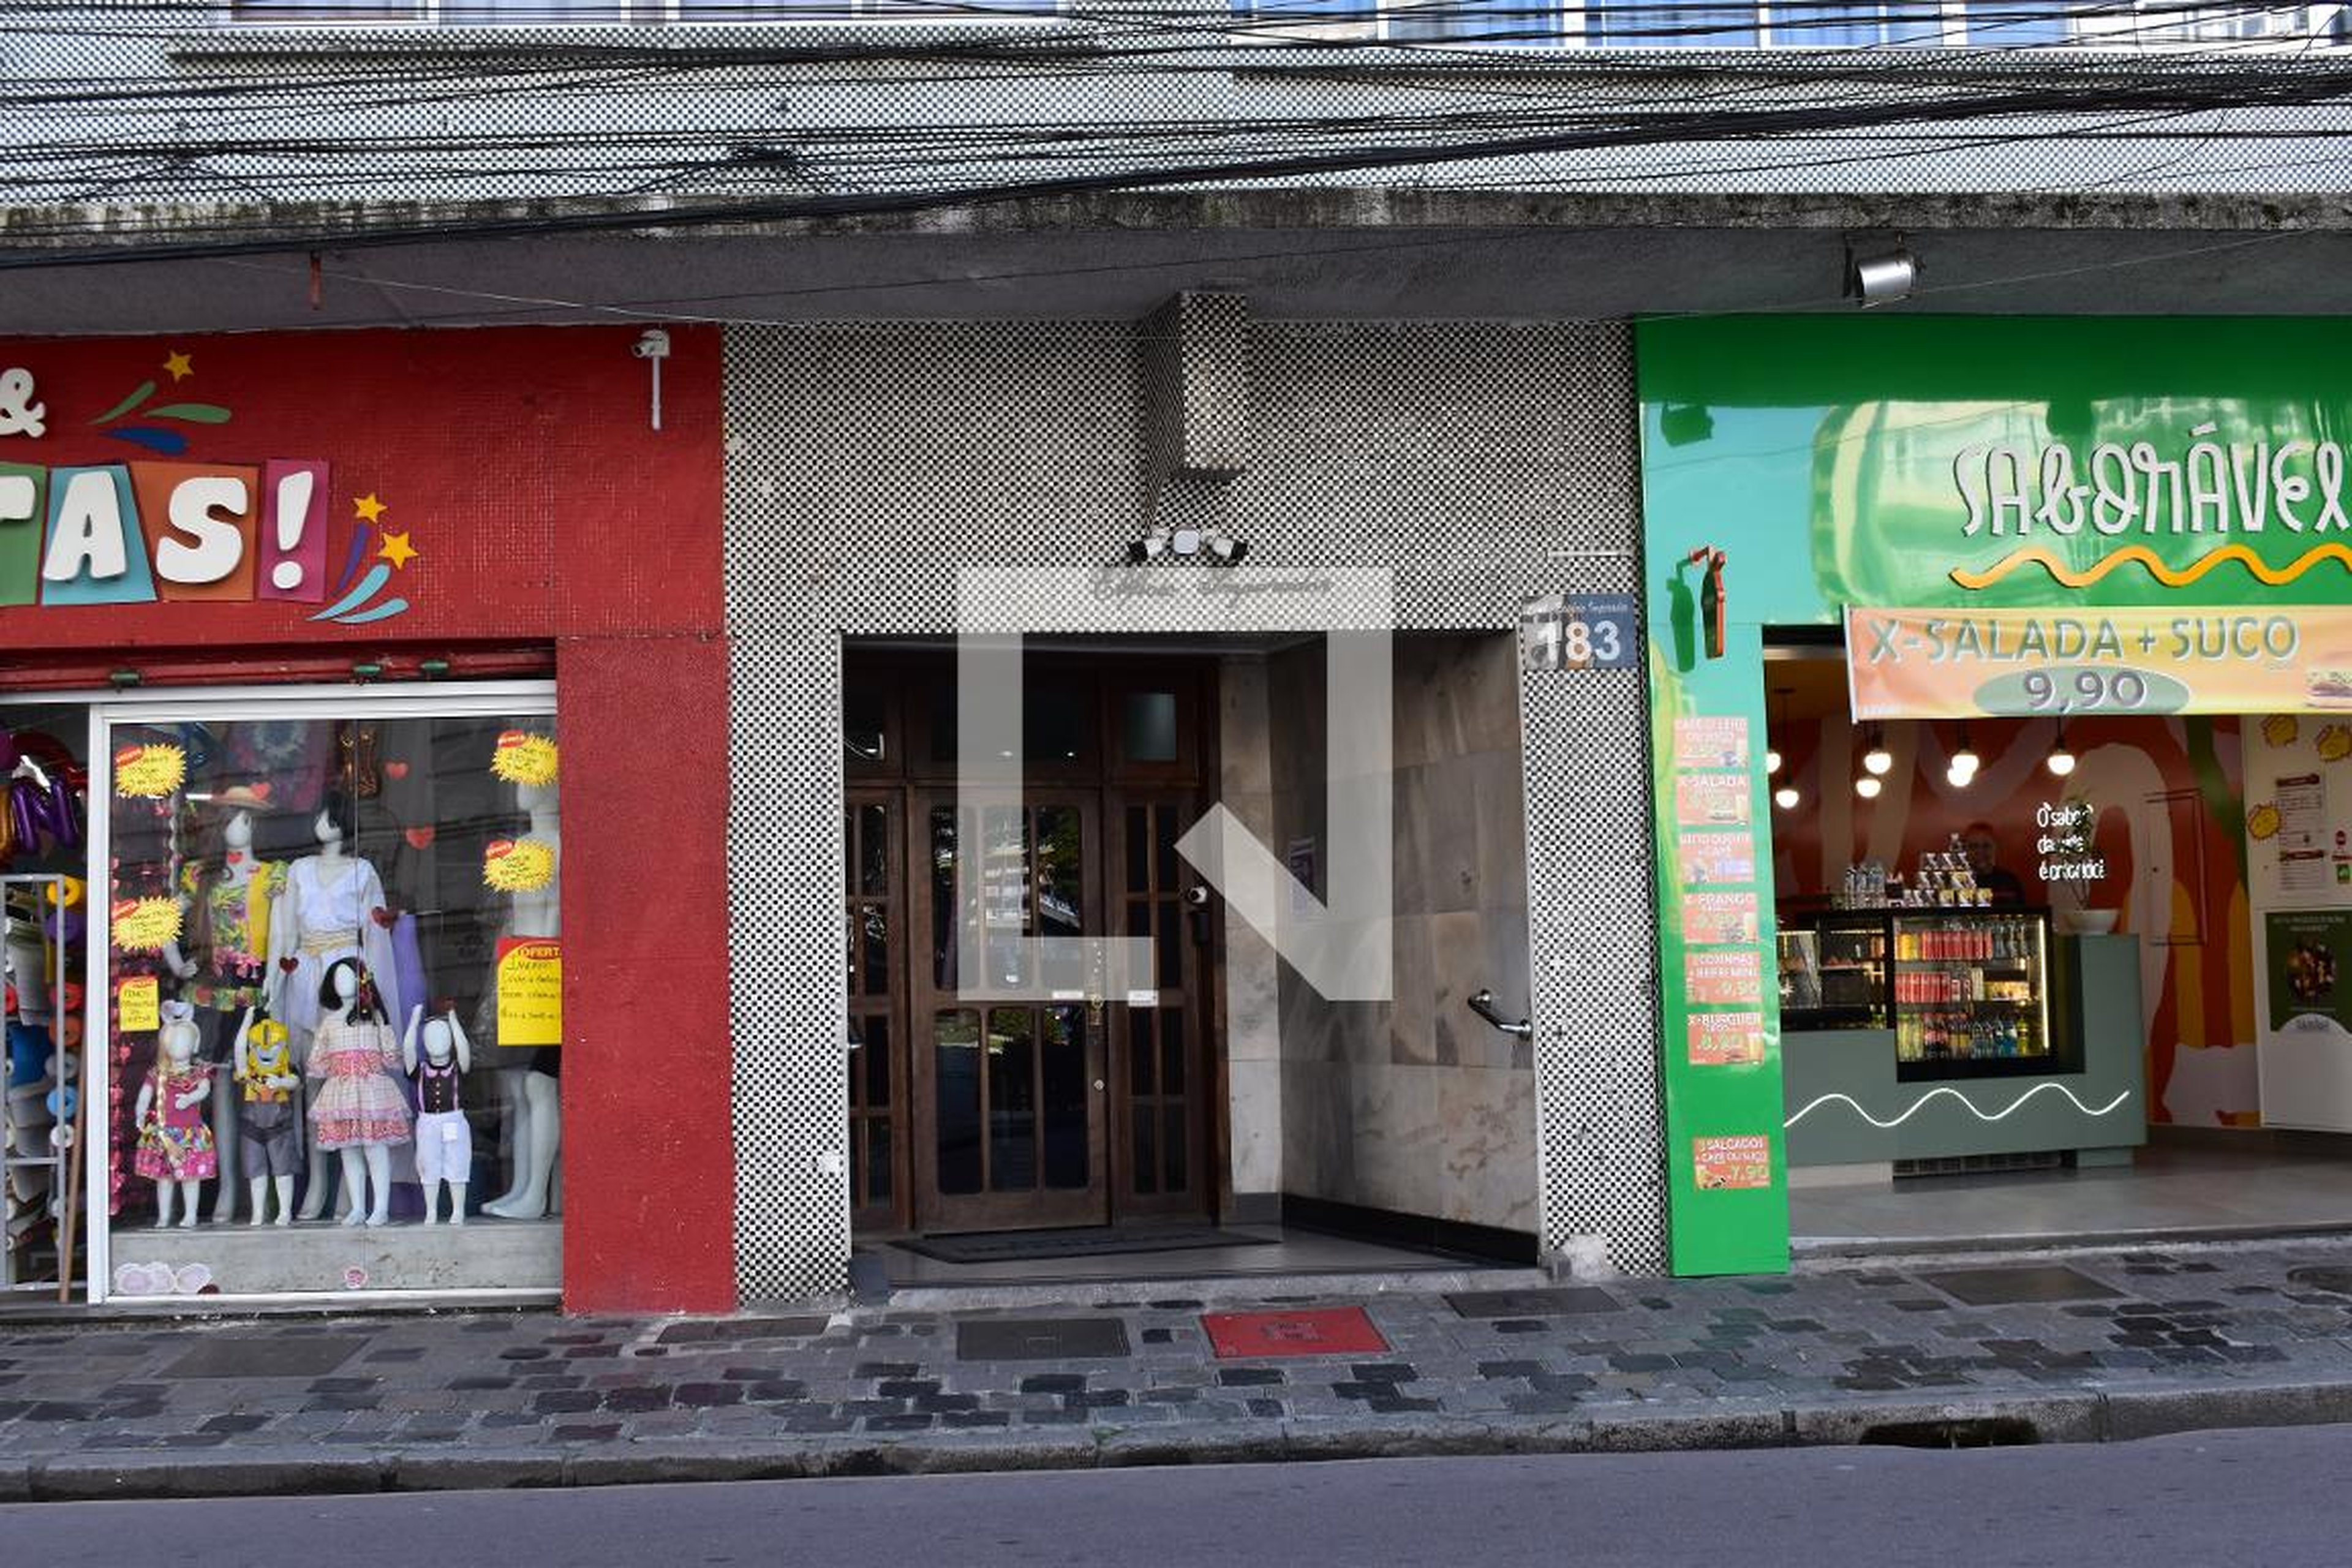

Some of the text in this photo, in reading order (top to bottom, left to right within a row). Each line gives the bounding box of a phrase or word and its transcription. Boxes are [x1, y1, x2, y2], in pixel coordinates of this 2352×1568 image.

[1537, 620, 1621, 662] 183
[1870, 617, 2124, 663] X-SALADA
[2171, 616, 2299, 661] SUCO
[2024, 669, 2147, 714] 9,90
[519, 947, 561, 957] OFERT
